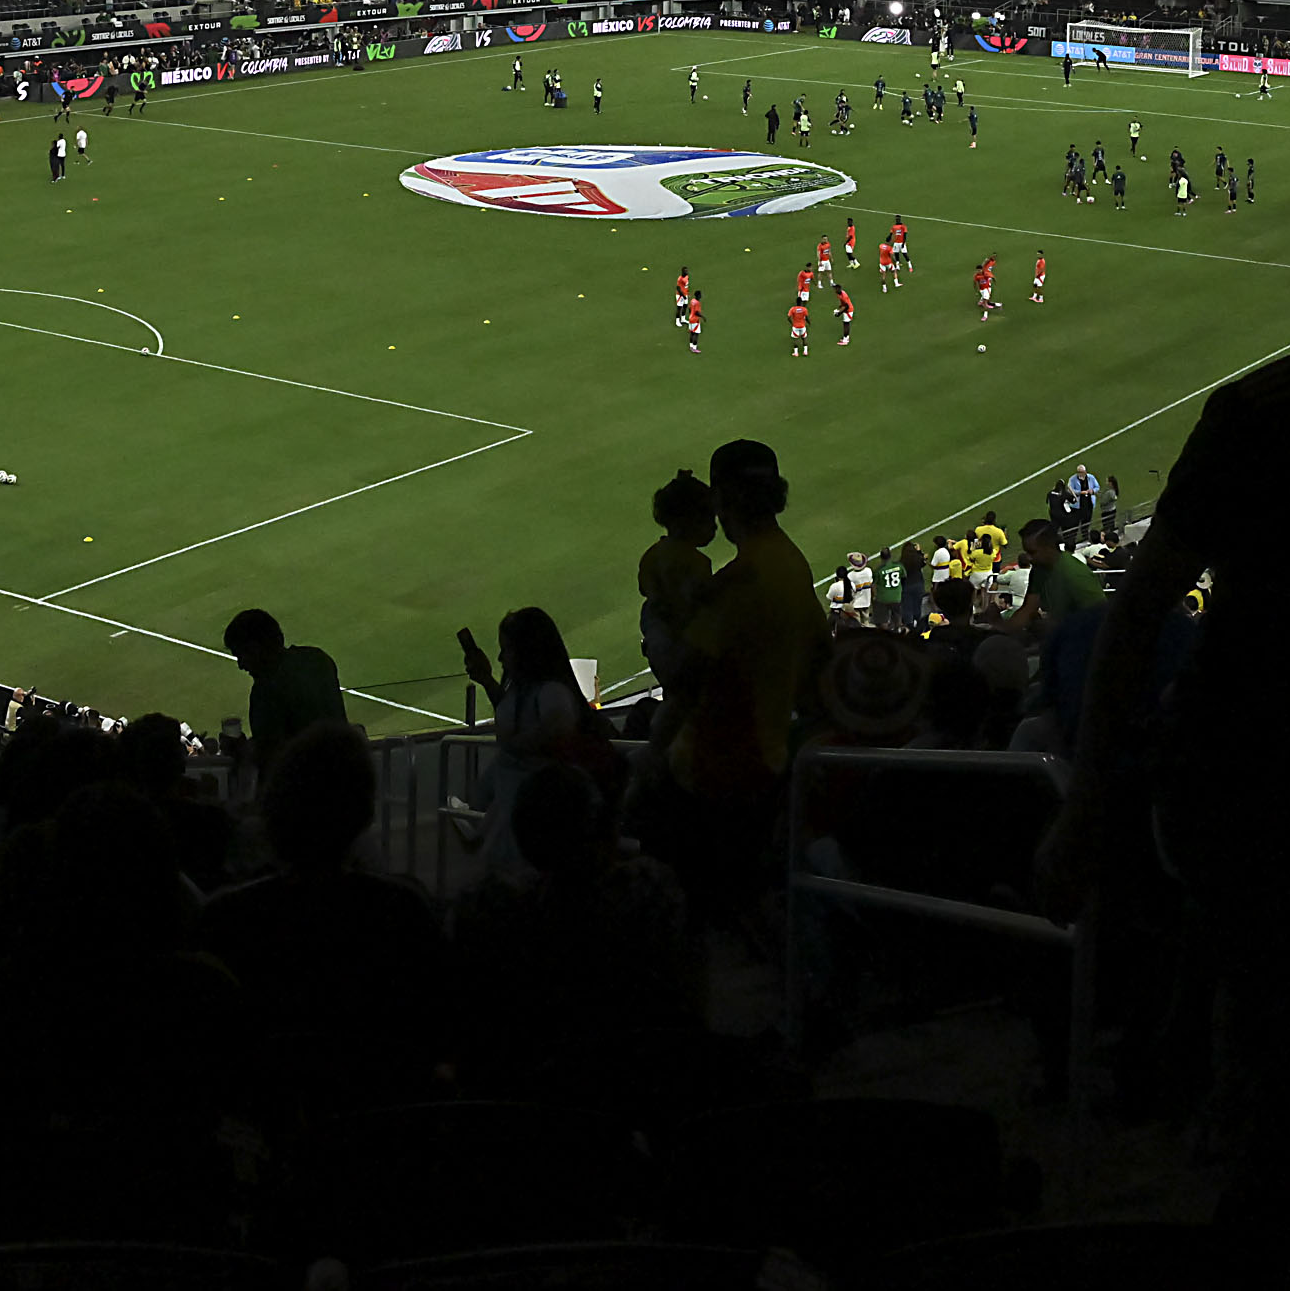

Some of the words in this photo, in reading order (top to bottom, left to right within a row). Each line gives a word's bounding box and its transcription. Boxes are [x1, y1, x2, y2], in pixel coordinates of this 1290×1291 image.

[637, 16, 656, 32] VS
[659, 16, 712, 30] COLOMBIA
[719, 19, 750, 30] PRESENTED
[21, 36, 42, 48] AT&T
[475, 29, 492, 47] VS
[161, 65, 213, 86] MÉXICO
[241, 56, 289, 75] COLOMBIA
[294, 55, 321, 67] PRESENTED
[884, 571, 900, 588] 18
